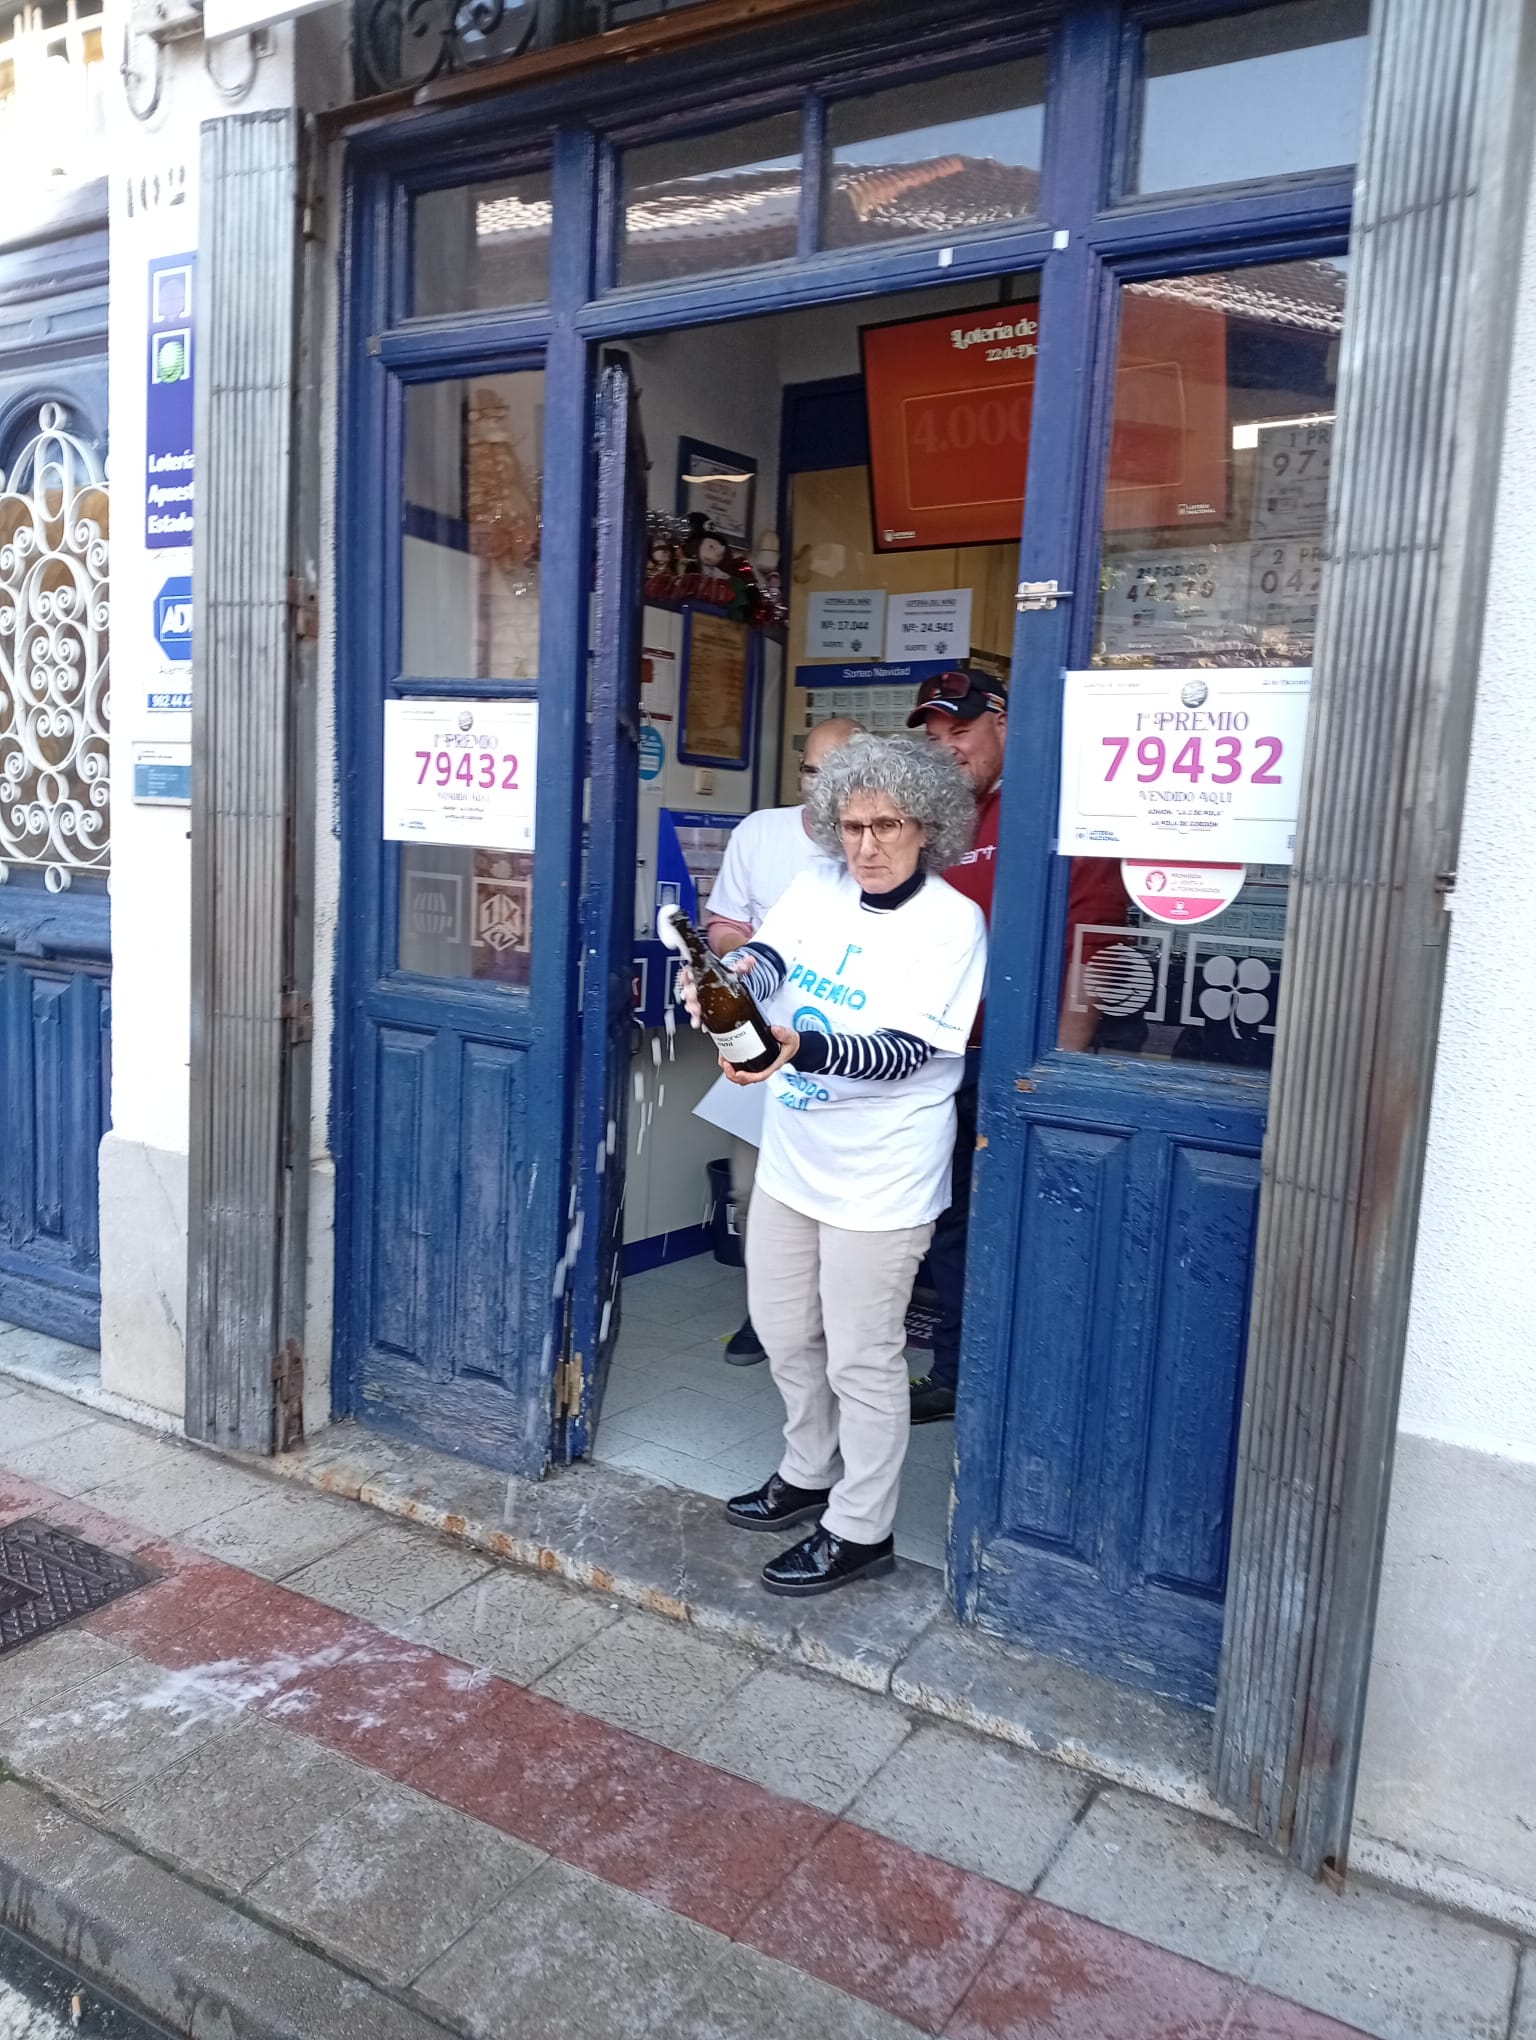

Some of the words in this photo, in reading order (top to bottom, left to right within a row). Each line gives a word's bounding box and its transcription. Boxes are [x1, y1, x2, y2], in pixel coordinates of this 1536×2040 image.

[951, 321, 1014, 349] Lotería
[1015, 318, 1038, 336] de
[1154, 711, 1249, 731] PREMIO
[415, 751, 519, 790] 79432
[1102, 736, 1284, 785] 79432
[788, 964, 866, 1010] PREMIO
